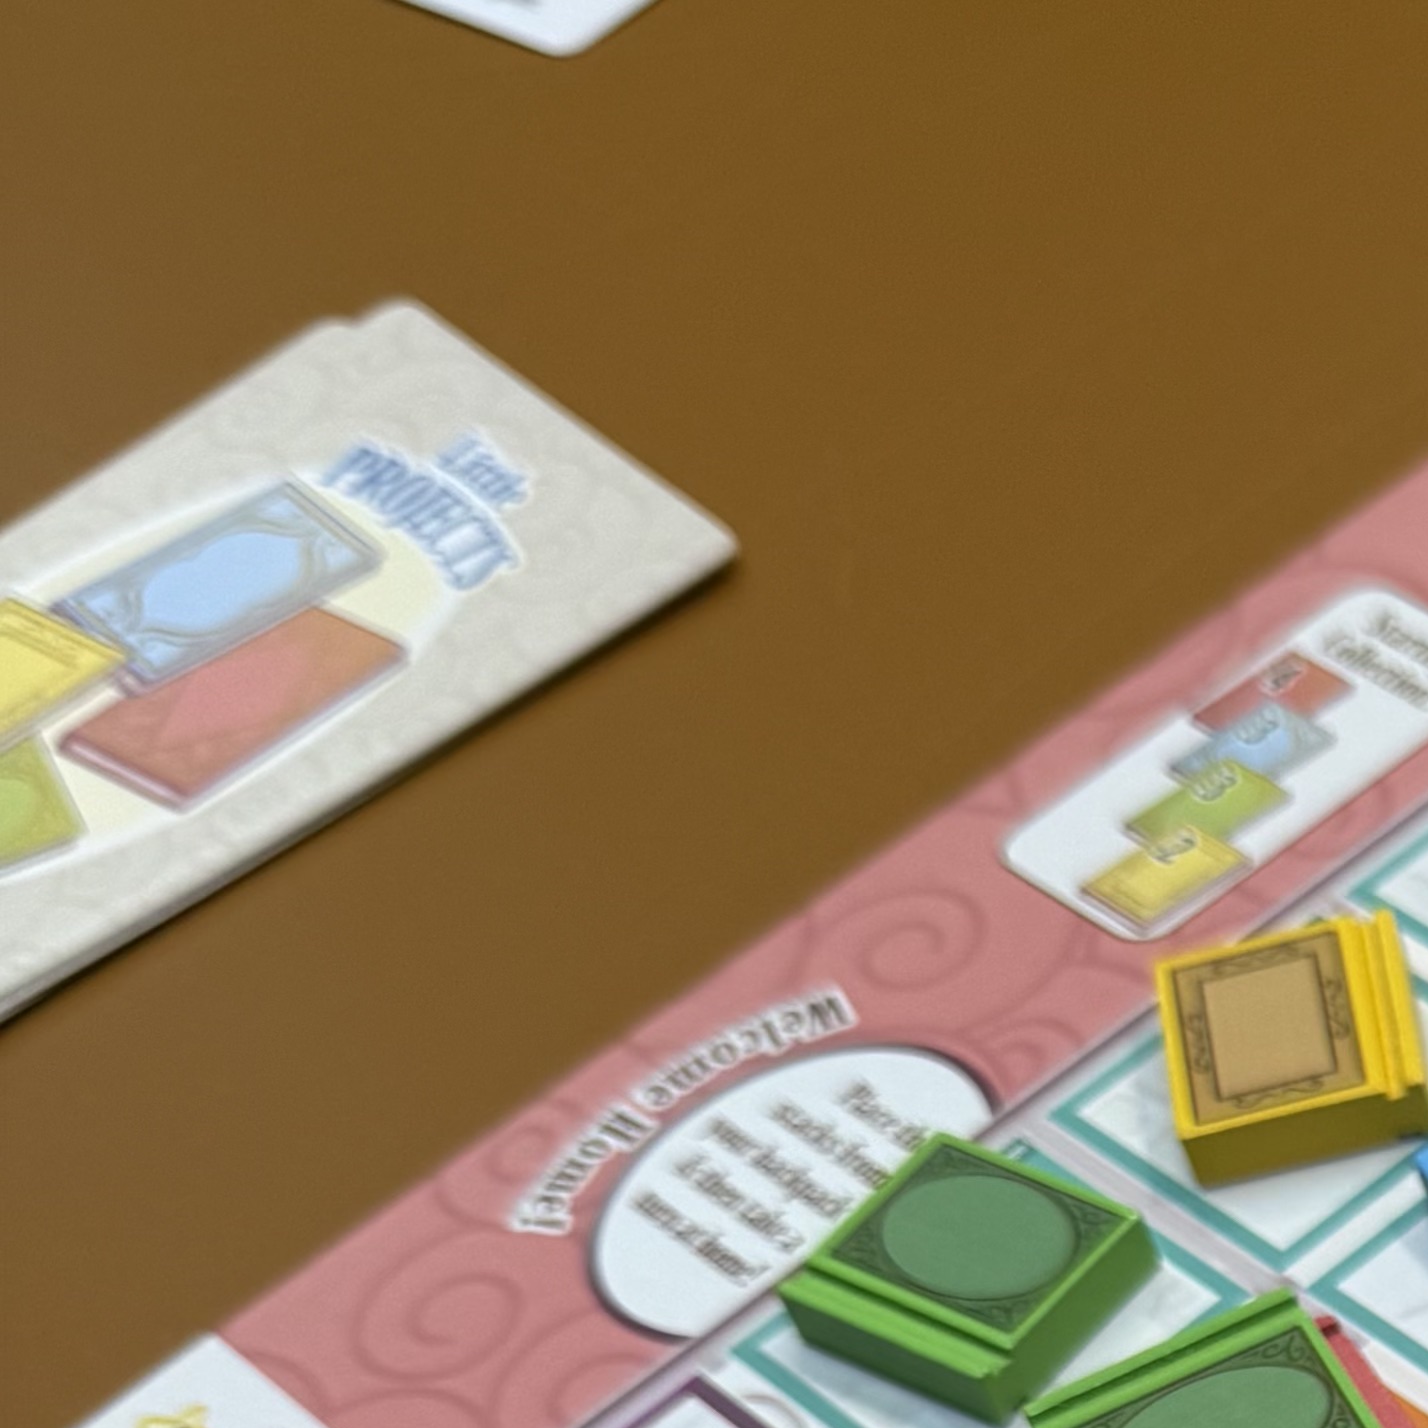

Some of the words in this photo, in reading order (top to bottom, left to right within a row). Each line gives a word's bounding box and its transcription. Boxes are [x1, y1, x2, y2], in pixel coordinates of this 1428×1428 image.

[322, 447, 515, 591] PROJECTS
[646, 995, 852, 1108] Welcome
[518, 1106, 655, 1232] Home!
